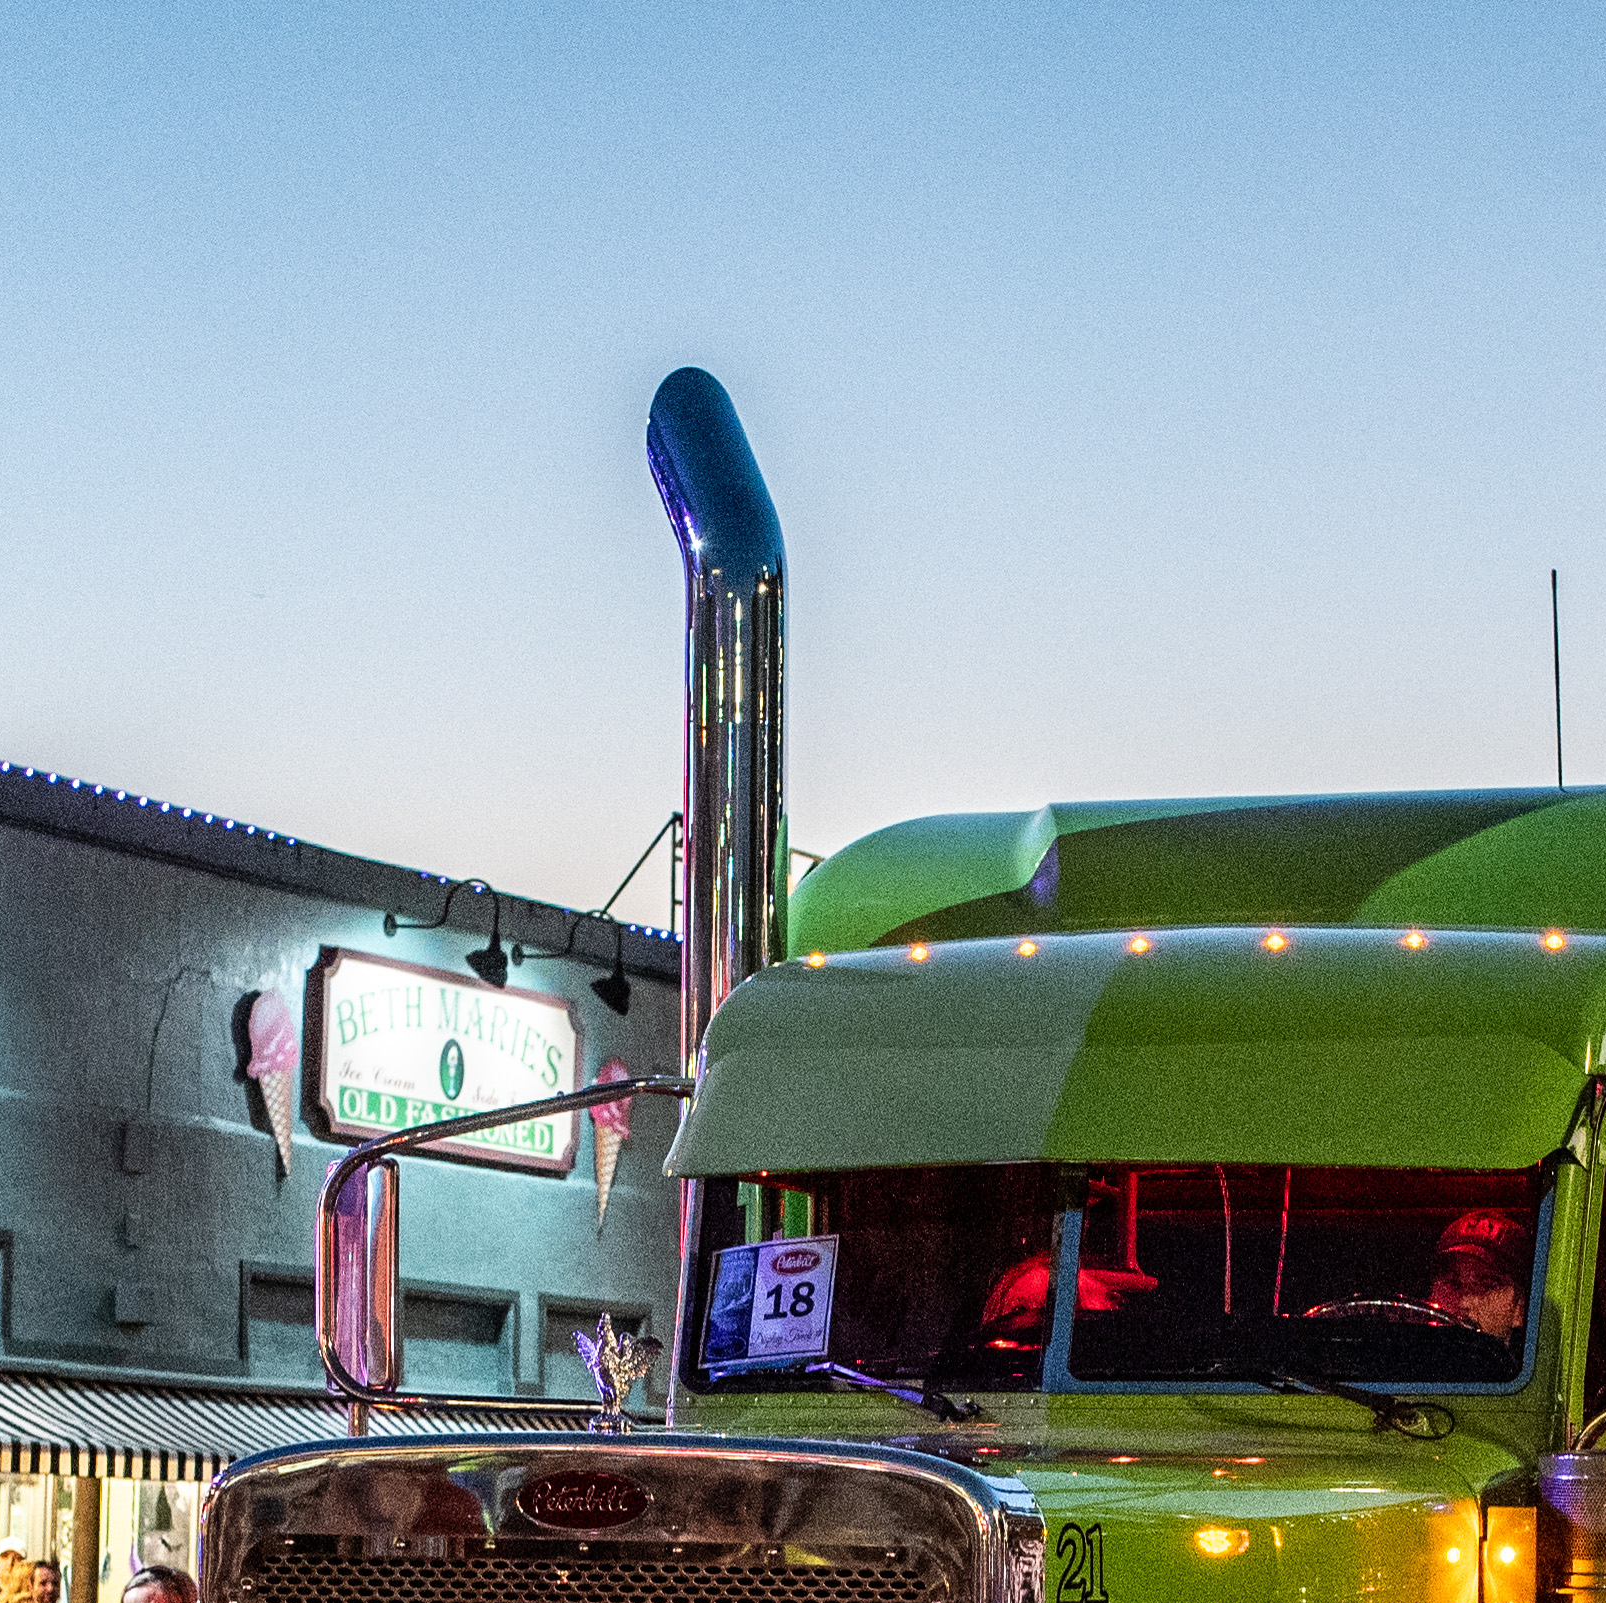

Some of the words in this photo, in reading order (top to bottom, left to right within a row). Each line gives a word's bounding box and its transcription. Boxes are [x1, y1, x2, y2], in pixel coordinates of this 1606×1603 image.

[336, 985, 424, 1046] BETH
[437, 986, 564, 1089] MARIE'S
[337, 1058, 364, 1081] Ice
[371, 1064, 417, 1091] Cream
[342, 1088, 398, 1126] OLD
[776, 1253, 818, 1270] Peterbilt
[763, 1281, 815, 1321] 18
[532, 1481, 630, 1514] Peterbilt
